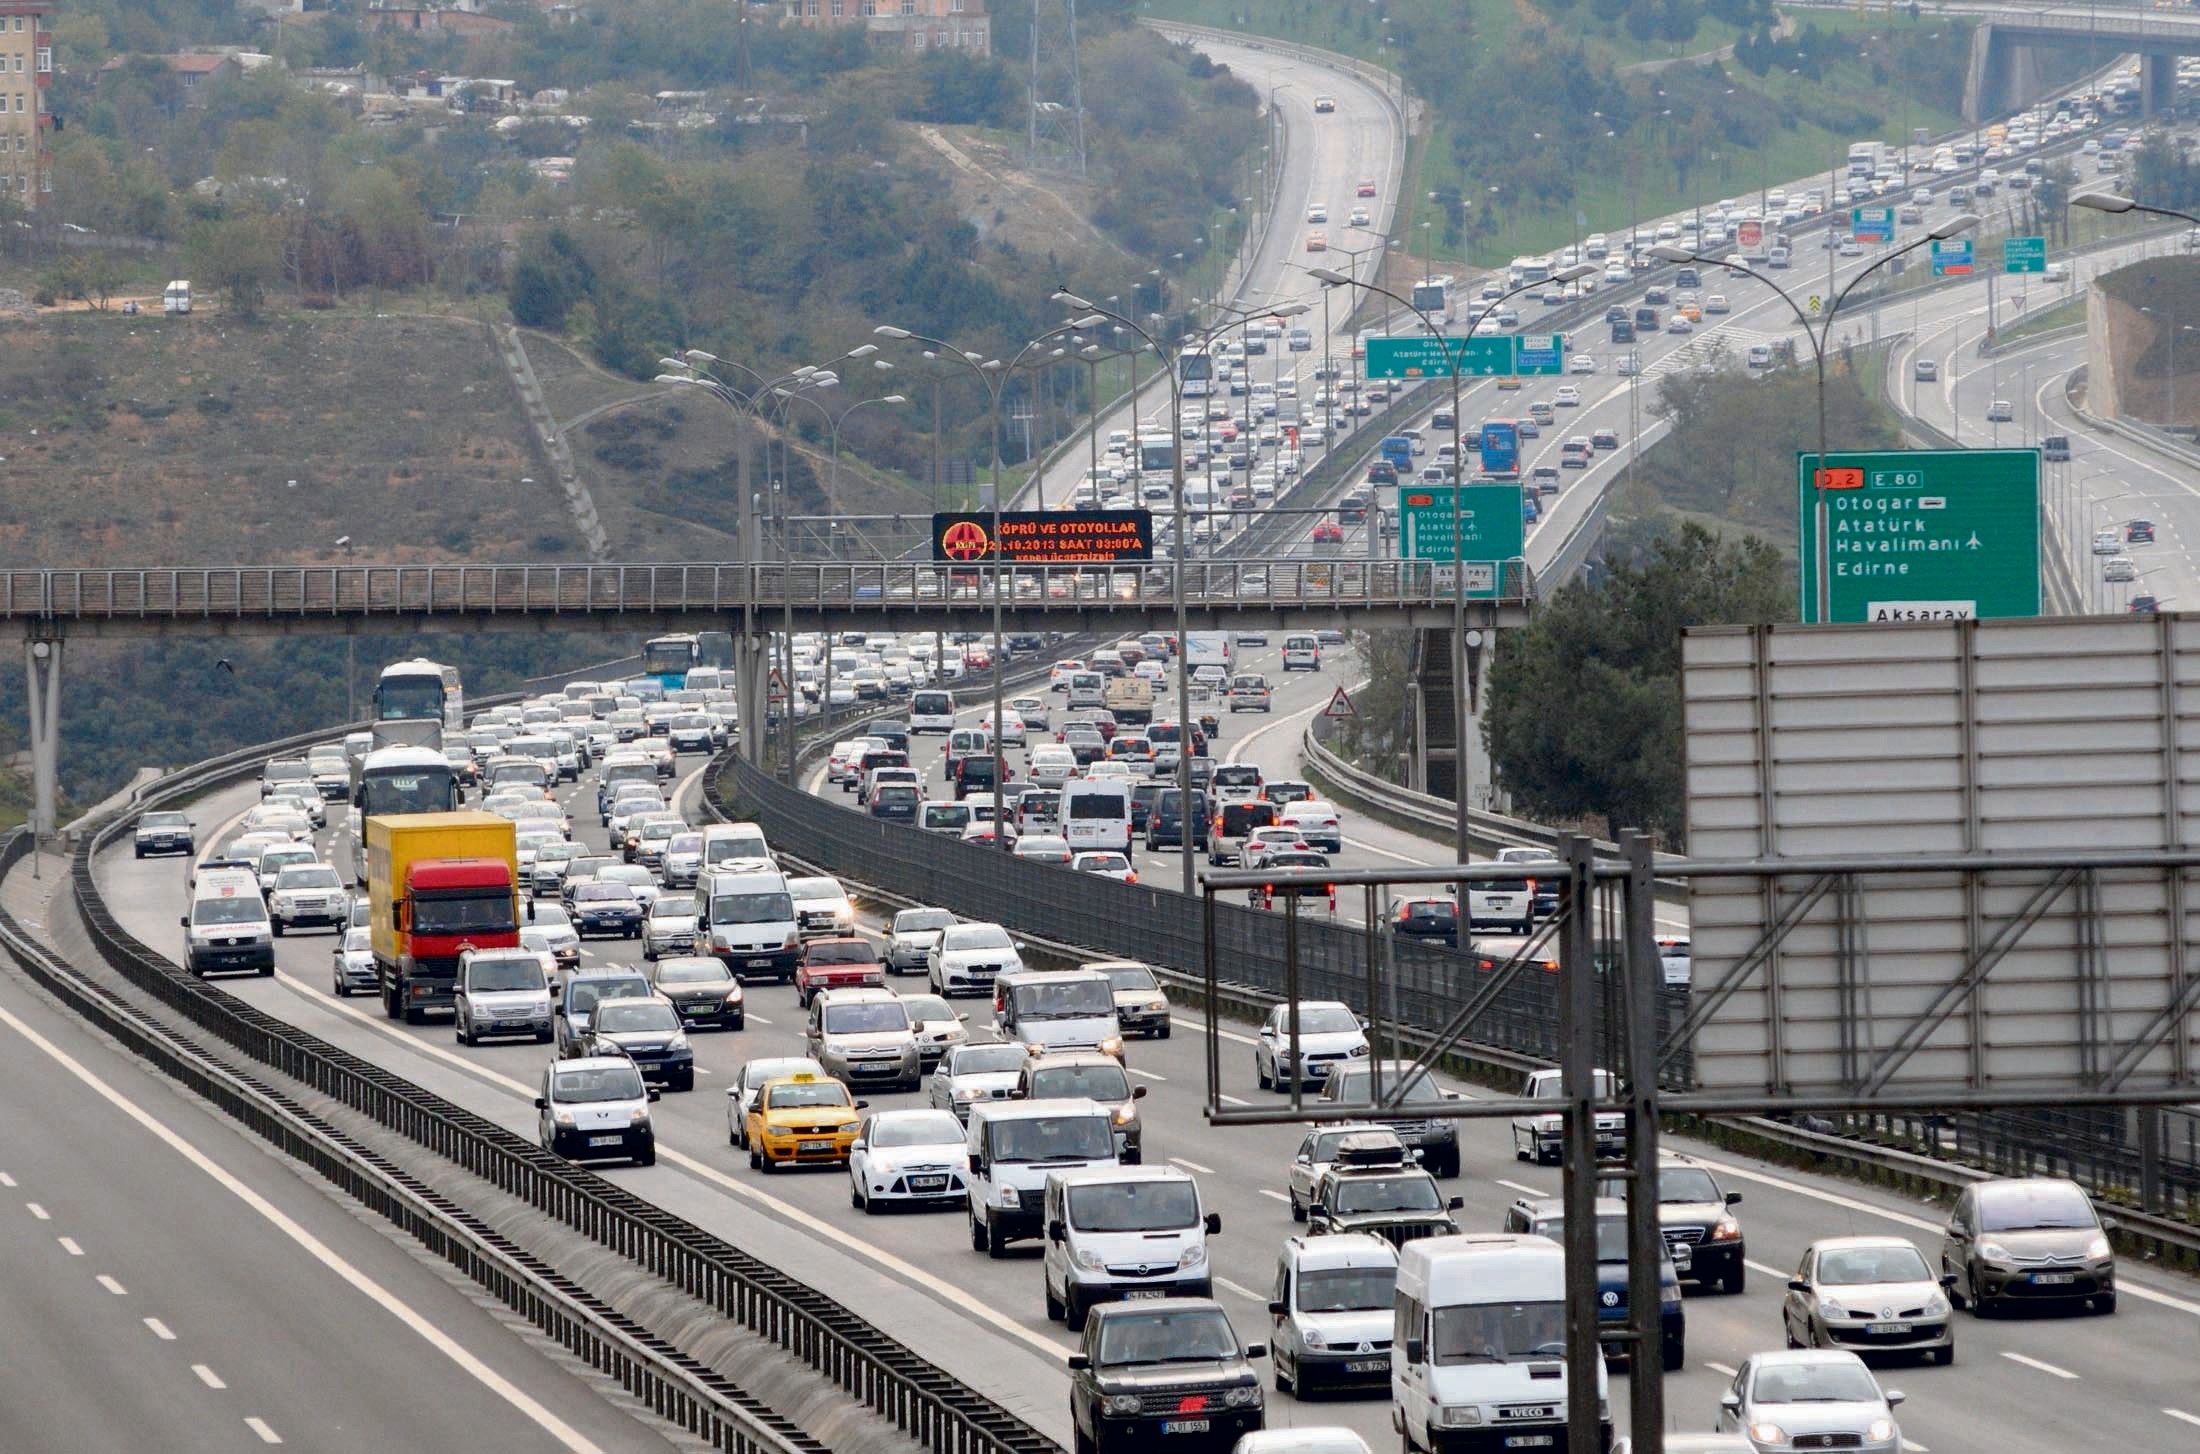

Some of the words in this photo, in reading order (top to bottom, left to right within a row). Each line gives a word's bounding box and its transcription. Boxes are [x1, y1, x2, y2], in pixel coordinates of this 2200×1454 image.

[1836, 497, 1913, 514] Otogar
[1040, 524, 1057, 534] VE
[1060, 522, 1136, 534] OTOYOLLAR
[1837, 518, 1926, 533] Atatürk
[988, 540, 1055, 551] 2.10.2013
[1059, 540, 1092, 550] SAAT
[1836, 538, 1960, 553] Havalimanı
[1837, 562, 1910, 577] Edirne
[1876, 608, 1969, 623] Aksaray
[1510, 1408, 1544, 1417] IVECO
